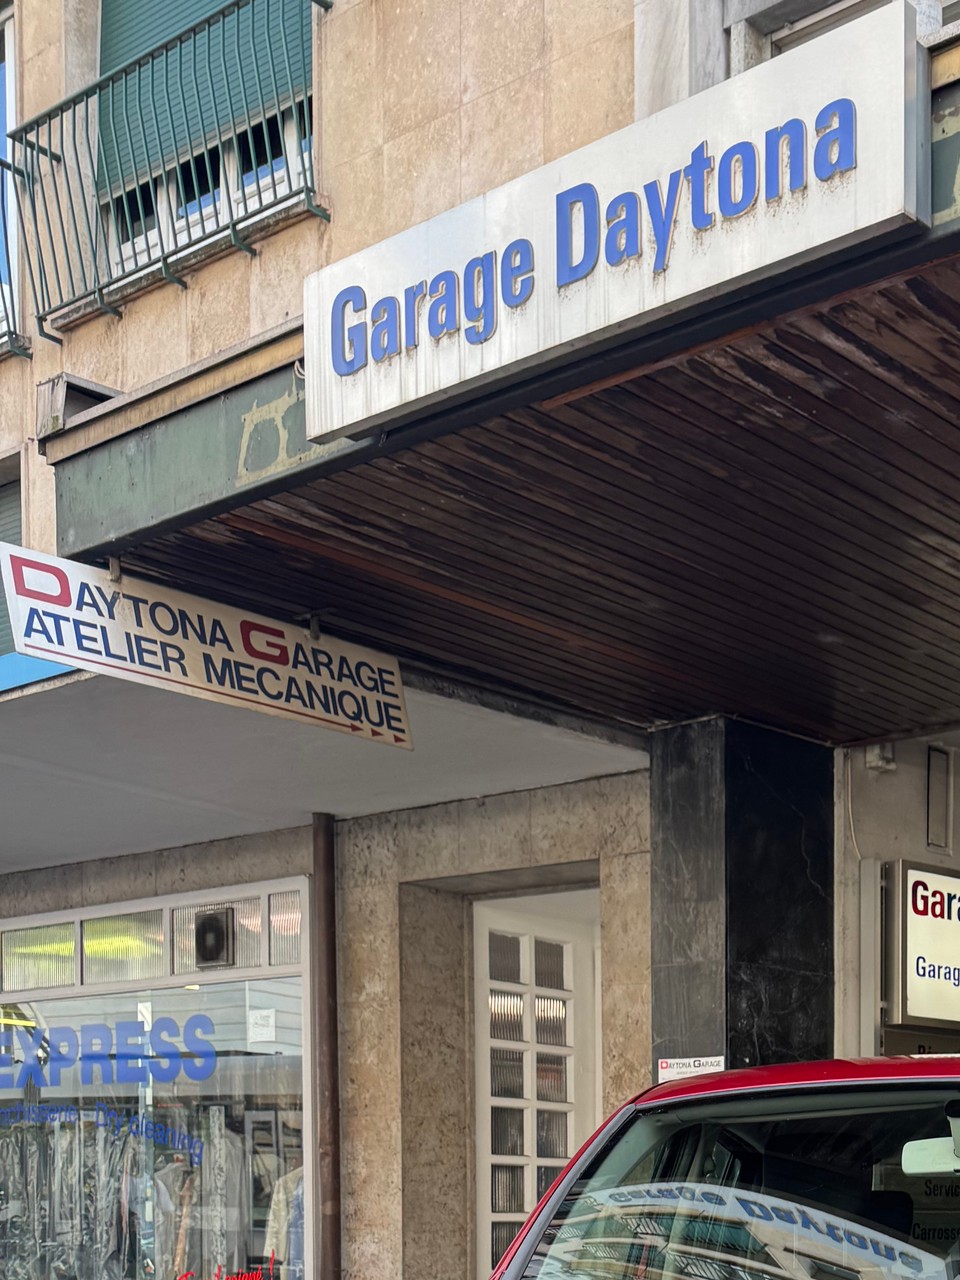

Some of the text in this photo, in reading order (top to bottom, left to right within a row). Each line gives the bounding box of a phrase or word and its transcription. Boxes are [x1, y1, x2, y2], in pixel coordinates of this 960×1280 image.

[331, 98, 858, 377] Garage Daytona
[10, 554, 400, 698] DAYTONA GARAGE
[24, 607, 406, 734] ATELIER MECANIQUE
[660, 1059, 722, 1069] DAYTONA GARAGE
